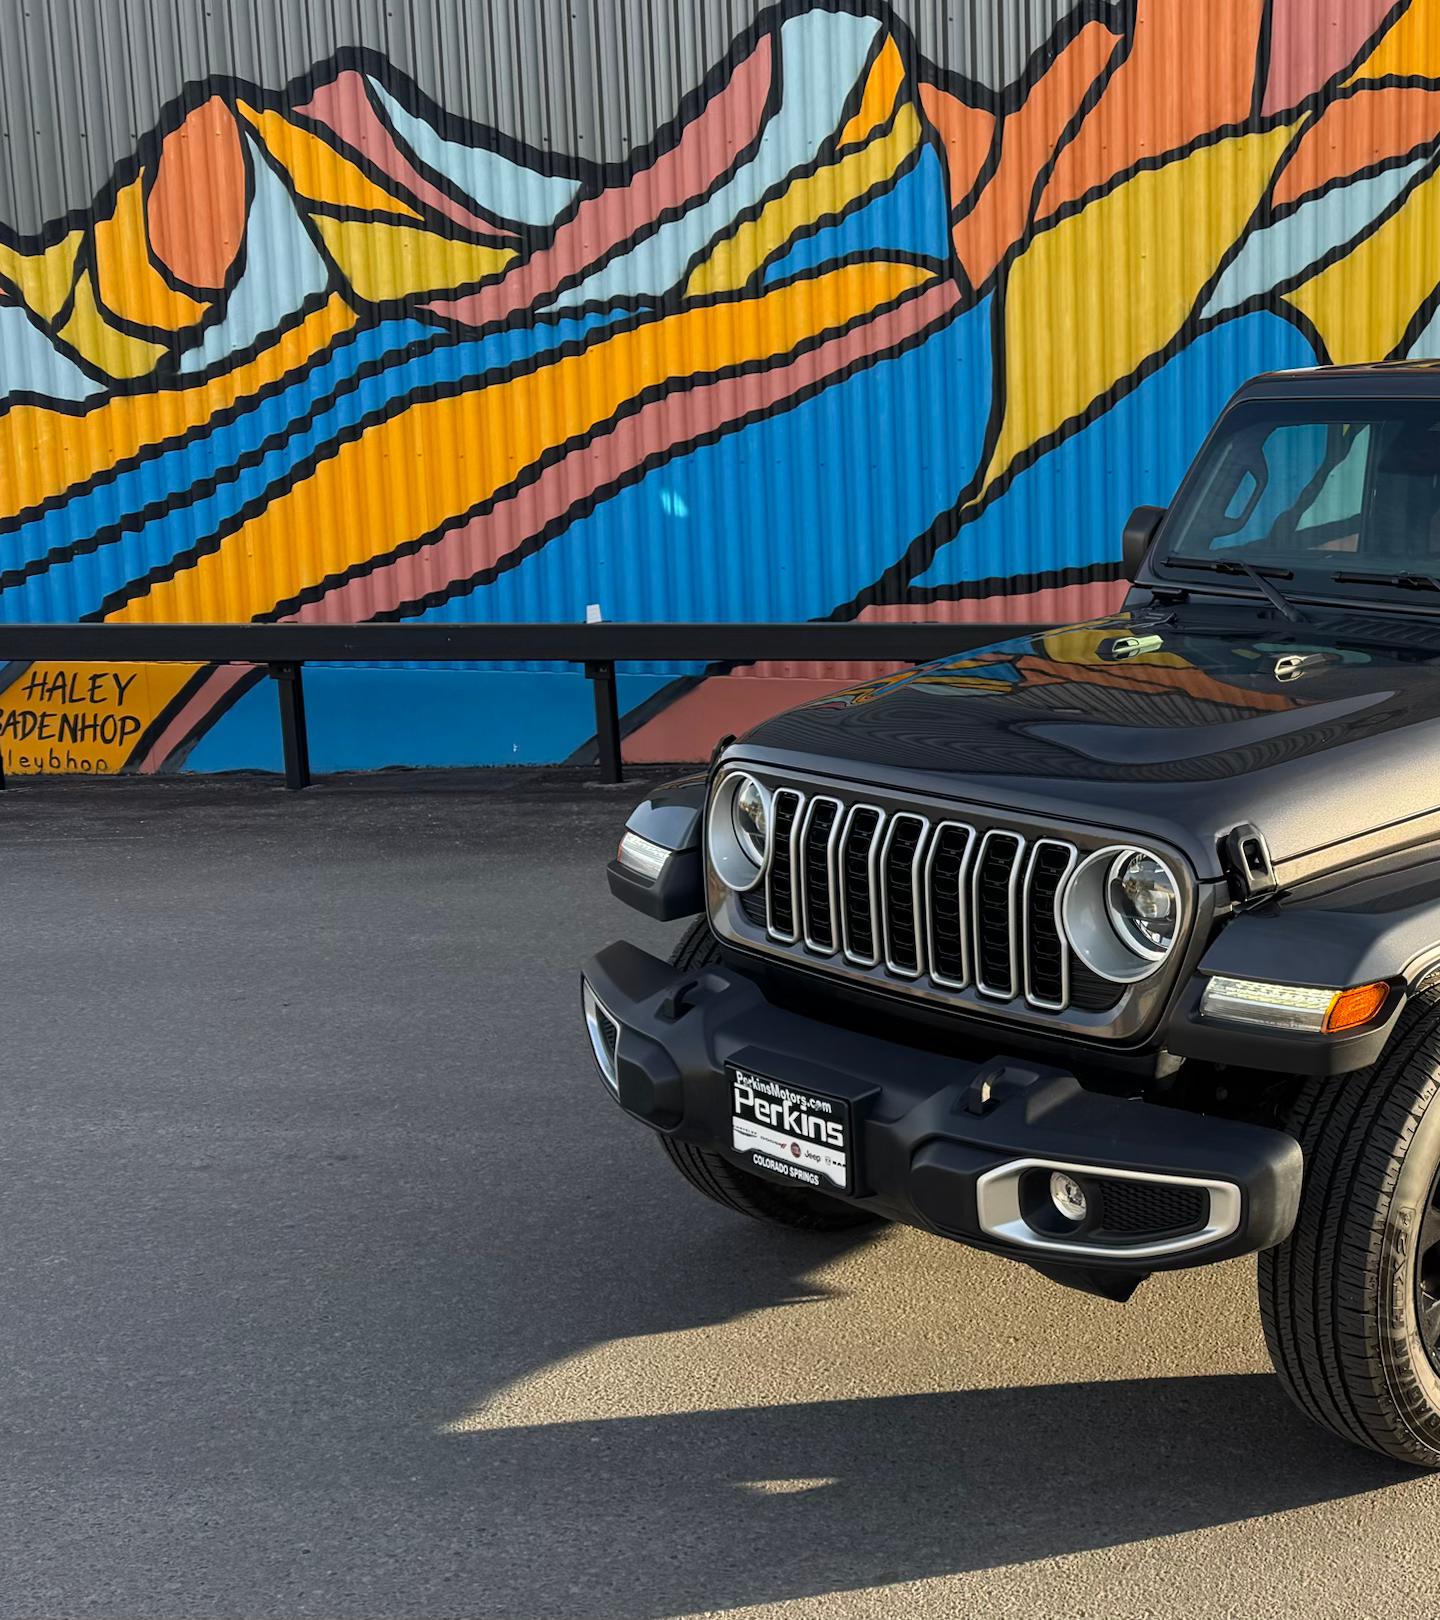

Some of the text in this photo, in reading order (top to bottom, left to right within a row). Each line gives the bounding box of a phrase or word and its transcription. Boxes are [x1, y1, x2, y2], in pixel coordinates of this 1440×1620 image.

[22, 671, 137, 706] HALEY
[736, 1071, 832, 1113] PerkinsMotors.com
[734, 1082, 843, 1147] Perkins
[753, 1154, 819, 1186] COLORADO SPRINGS
